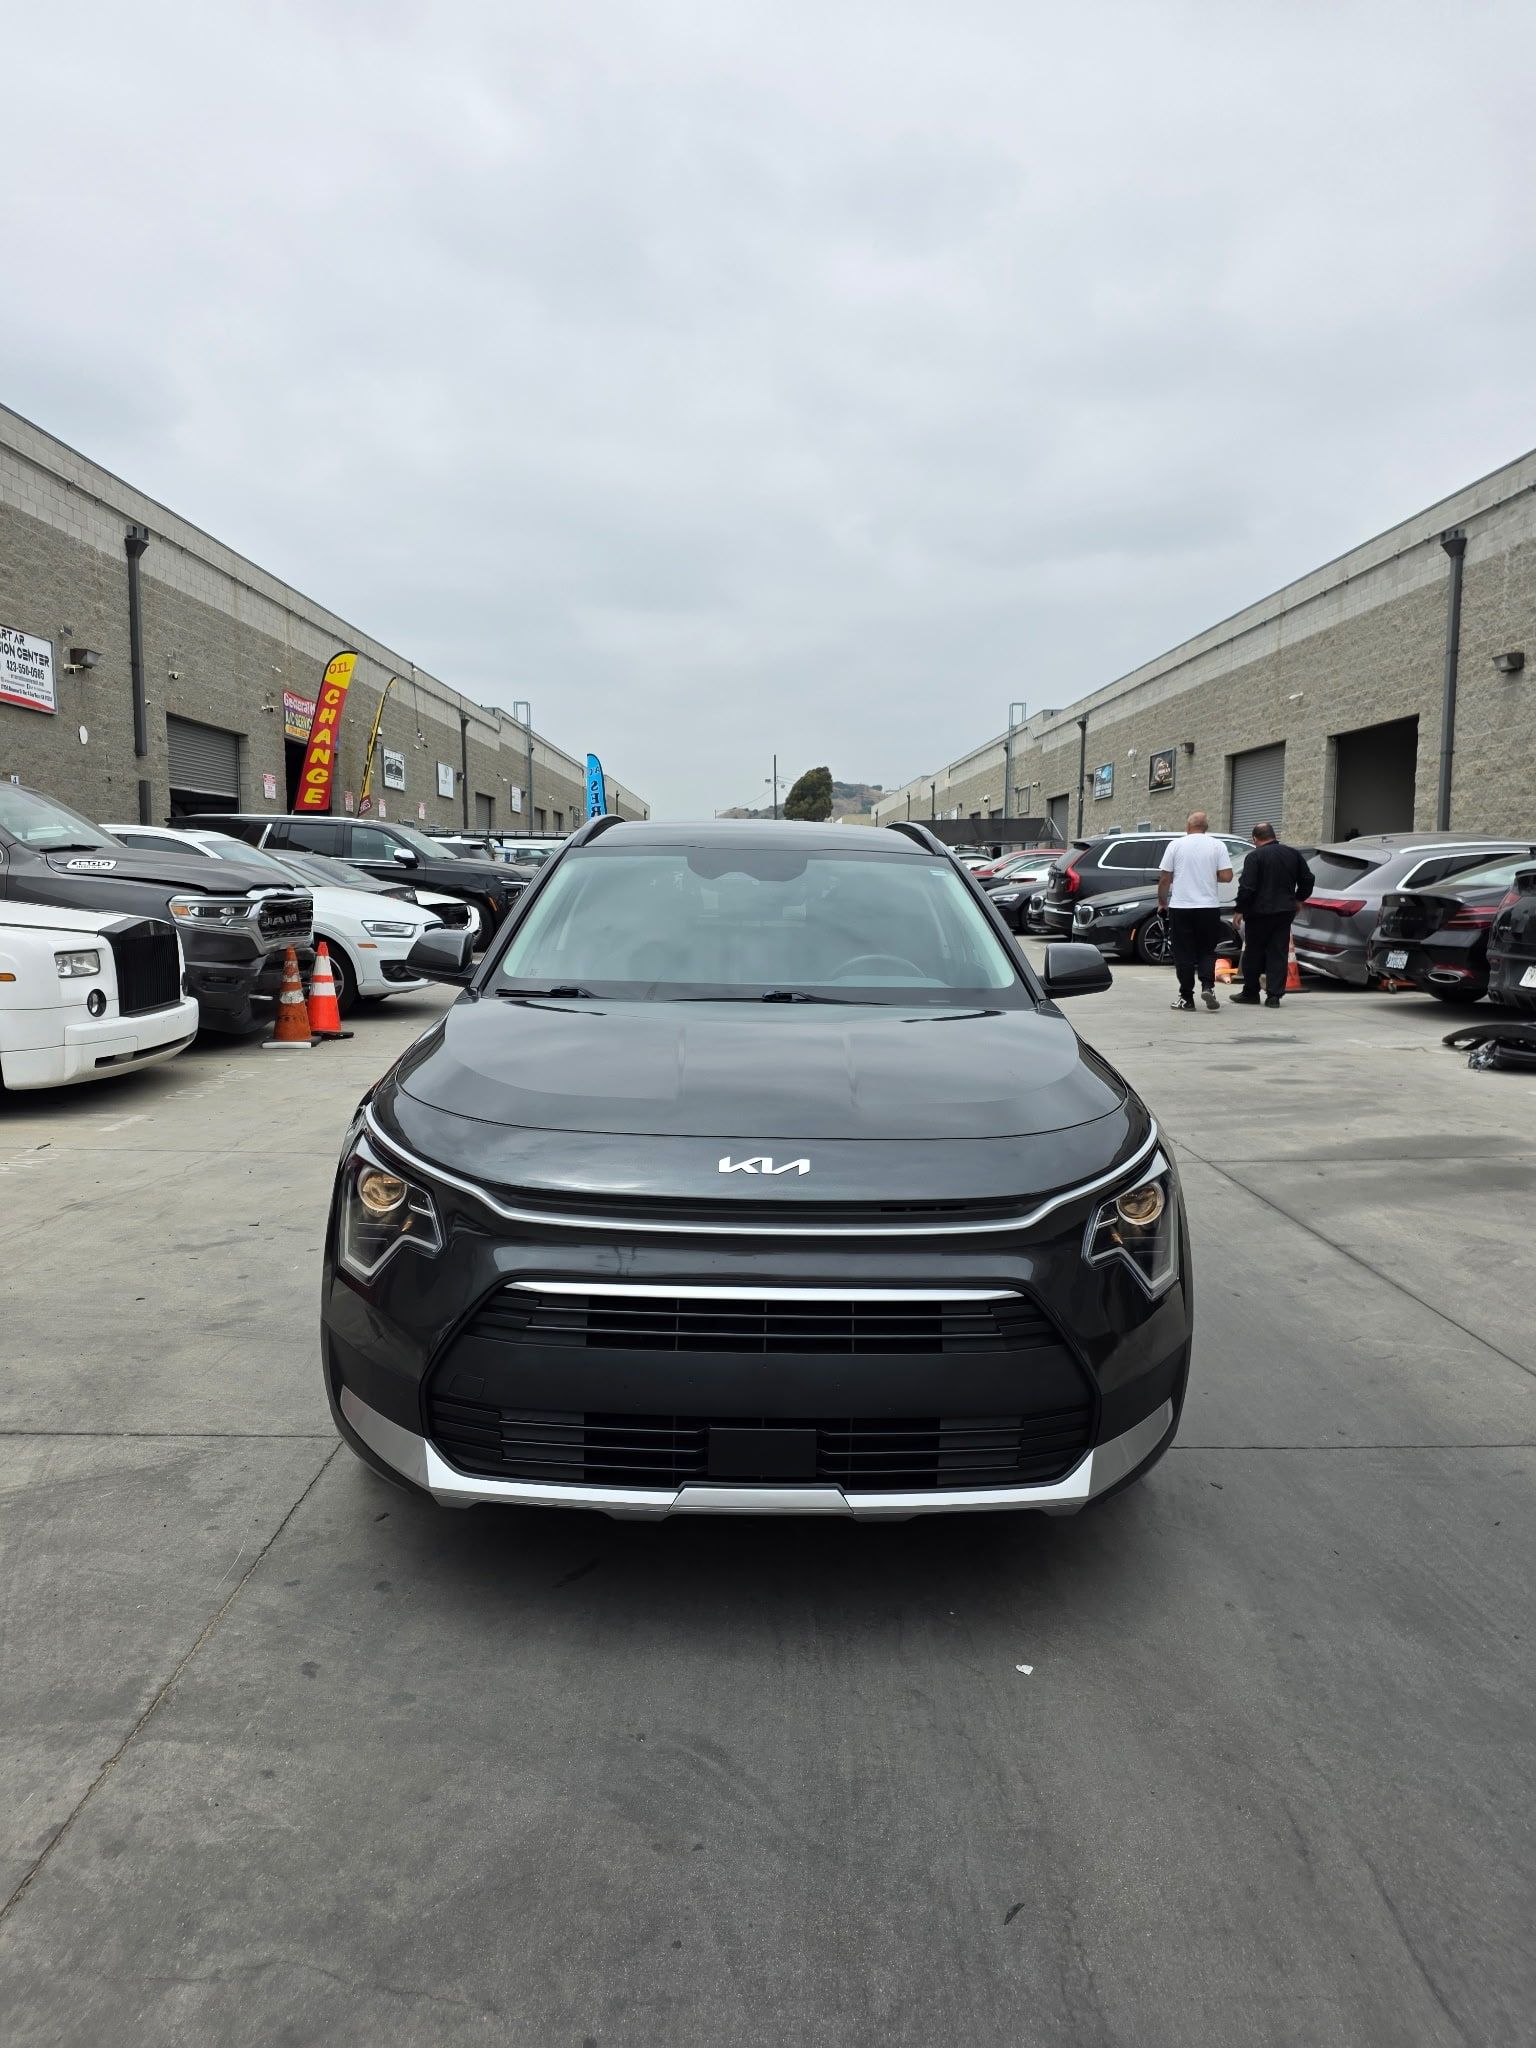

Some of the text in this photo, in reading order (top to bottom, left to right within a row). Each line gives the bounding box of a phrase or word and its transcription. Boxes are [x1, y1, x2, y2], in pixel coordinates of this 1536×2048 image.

[0, 629, 25, 646] RT AR
[17, 646, 50, 668] CENTER
[329, 661, 351, 674] OIL
[283, 692, 310, 715] General
[303, 688, 341, 804] CHANGE
[719, 1156, 811, 1177] KIA
